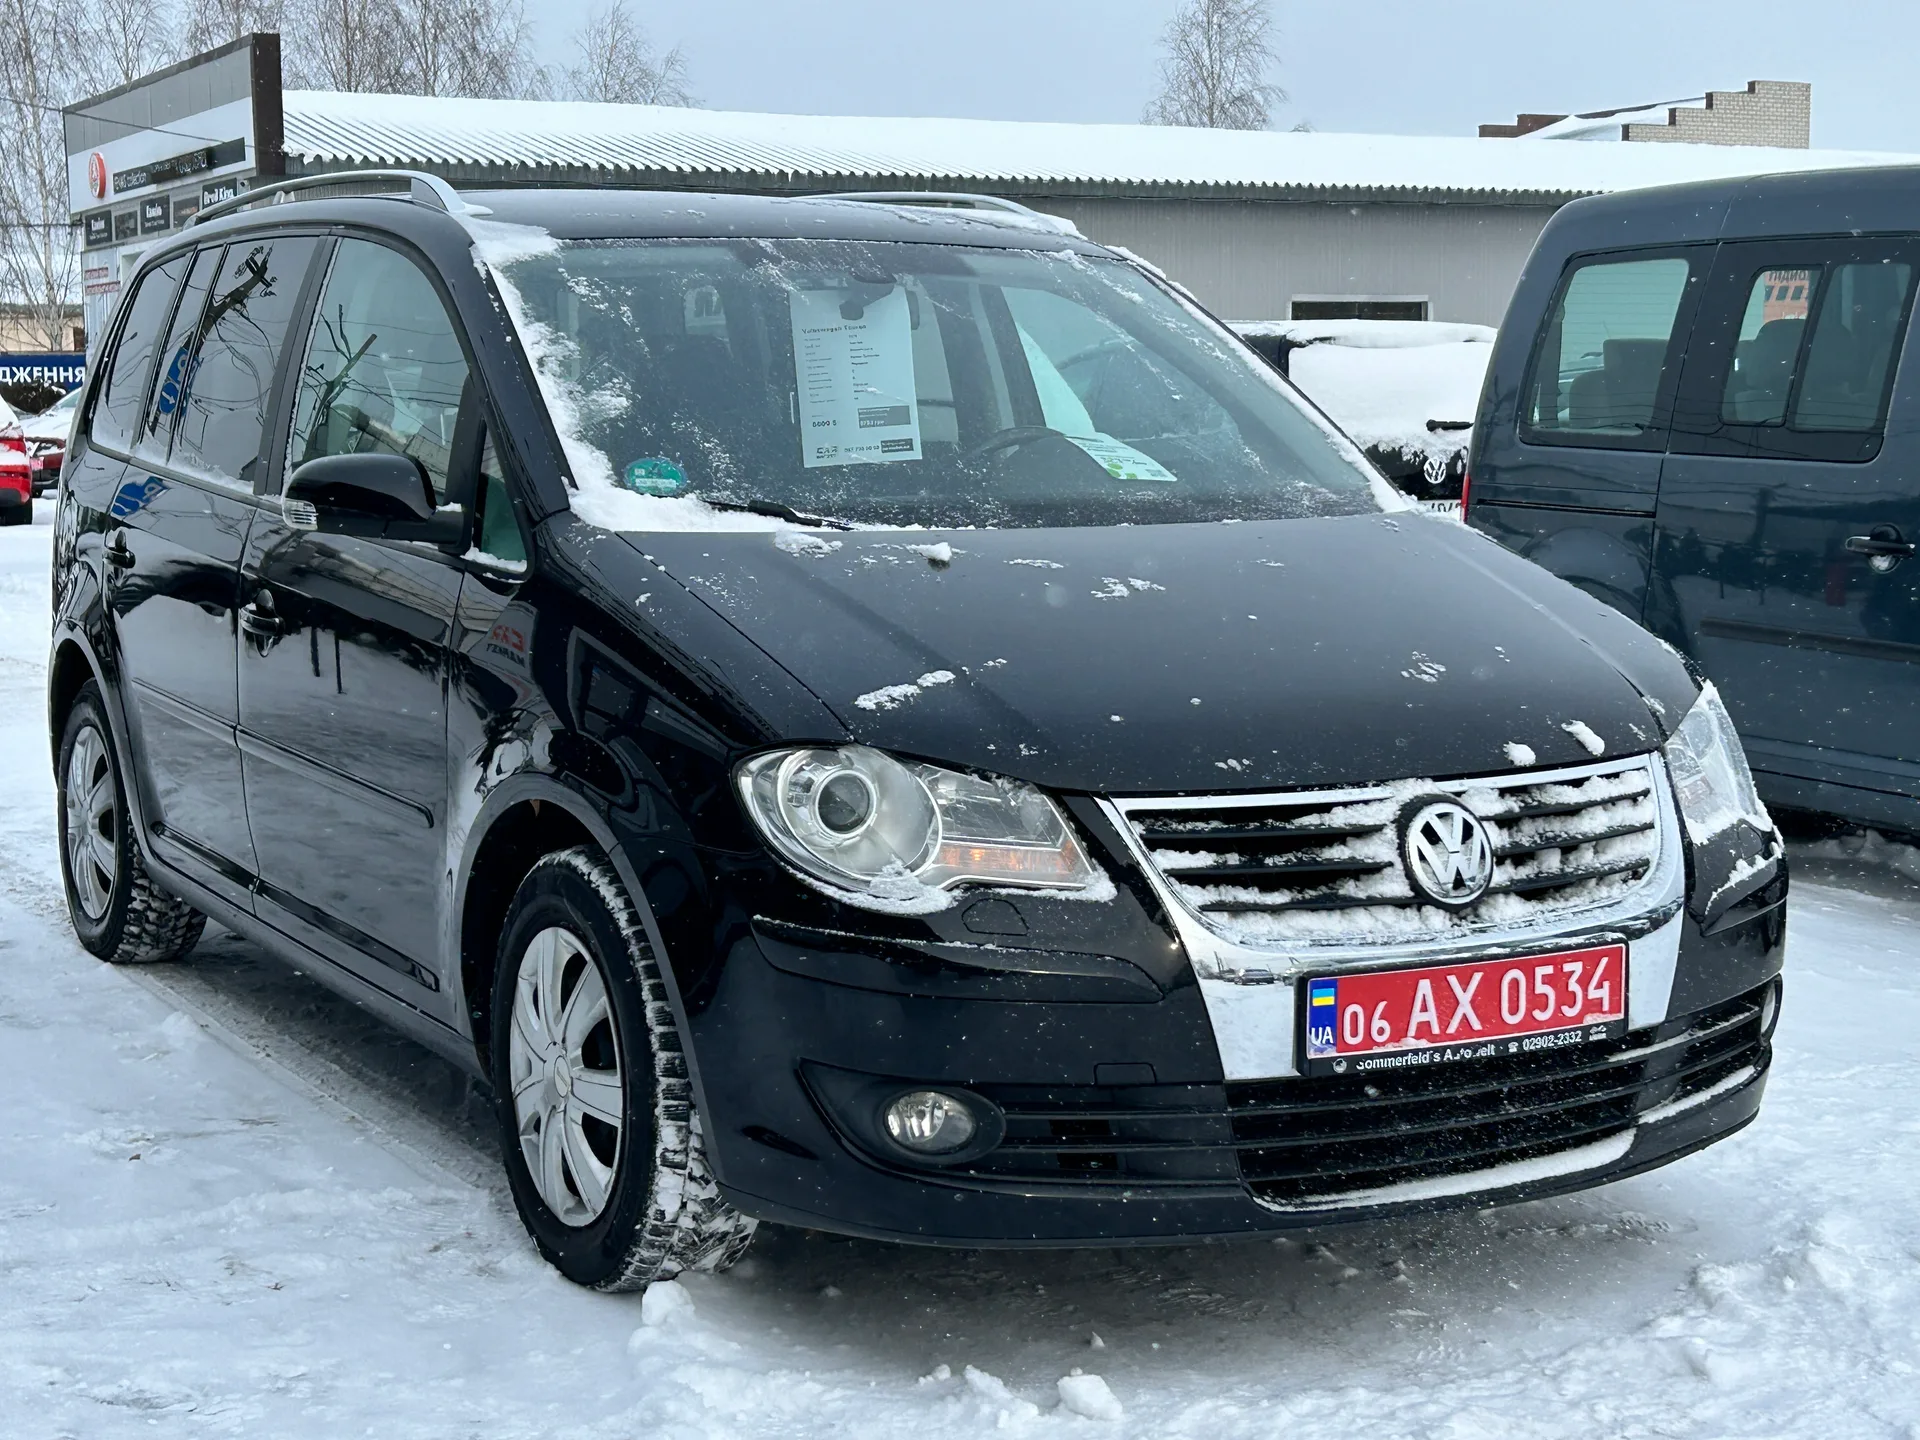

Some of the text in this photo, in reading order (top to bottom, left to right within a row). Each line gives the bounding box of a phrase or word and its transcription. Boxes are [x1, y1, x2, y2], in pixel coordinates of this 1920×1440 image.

[0, 366, 86, 387] ДЖЕННЯ
[1405, 802, 1492, 905] VW
[1343, 956, 1611, 1045] 06 AX 0534
[1310, 1027, 1334, 1045] UA
[1522, 1030, 1582, 1051] 02902-2332
